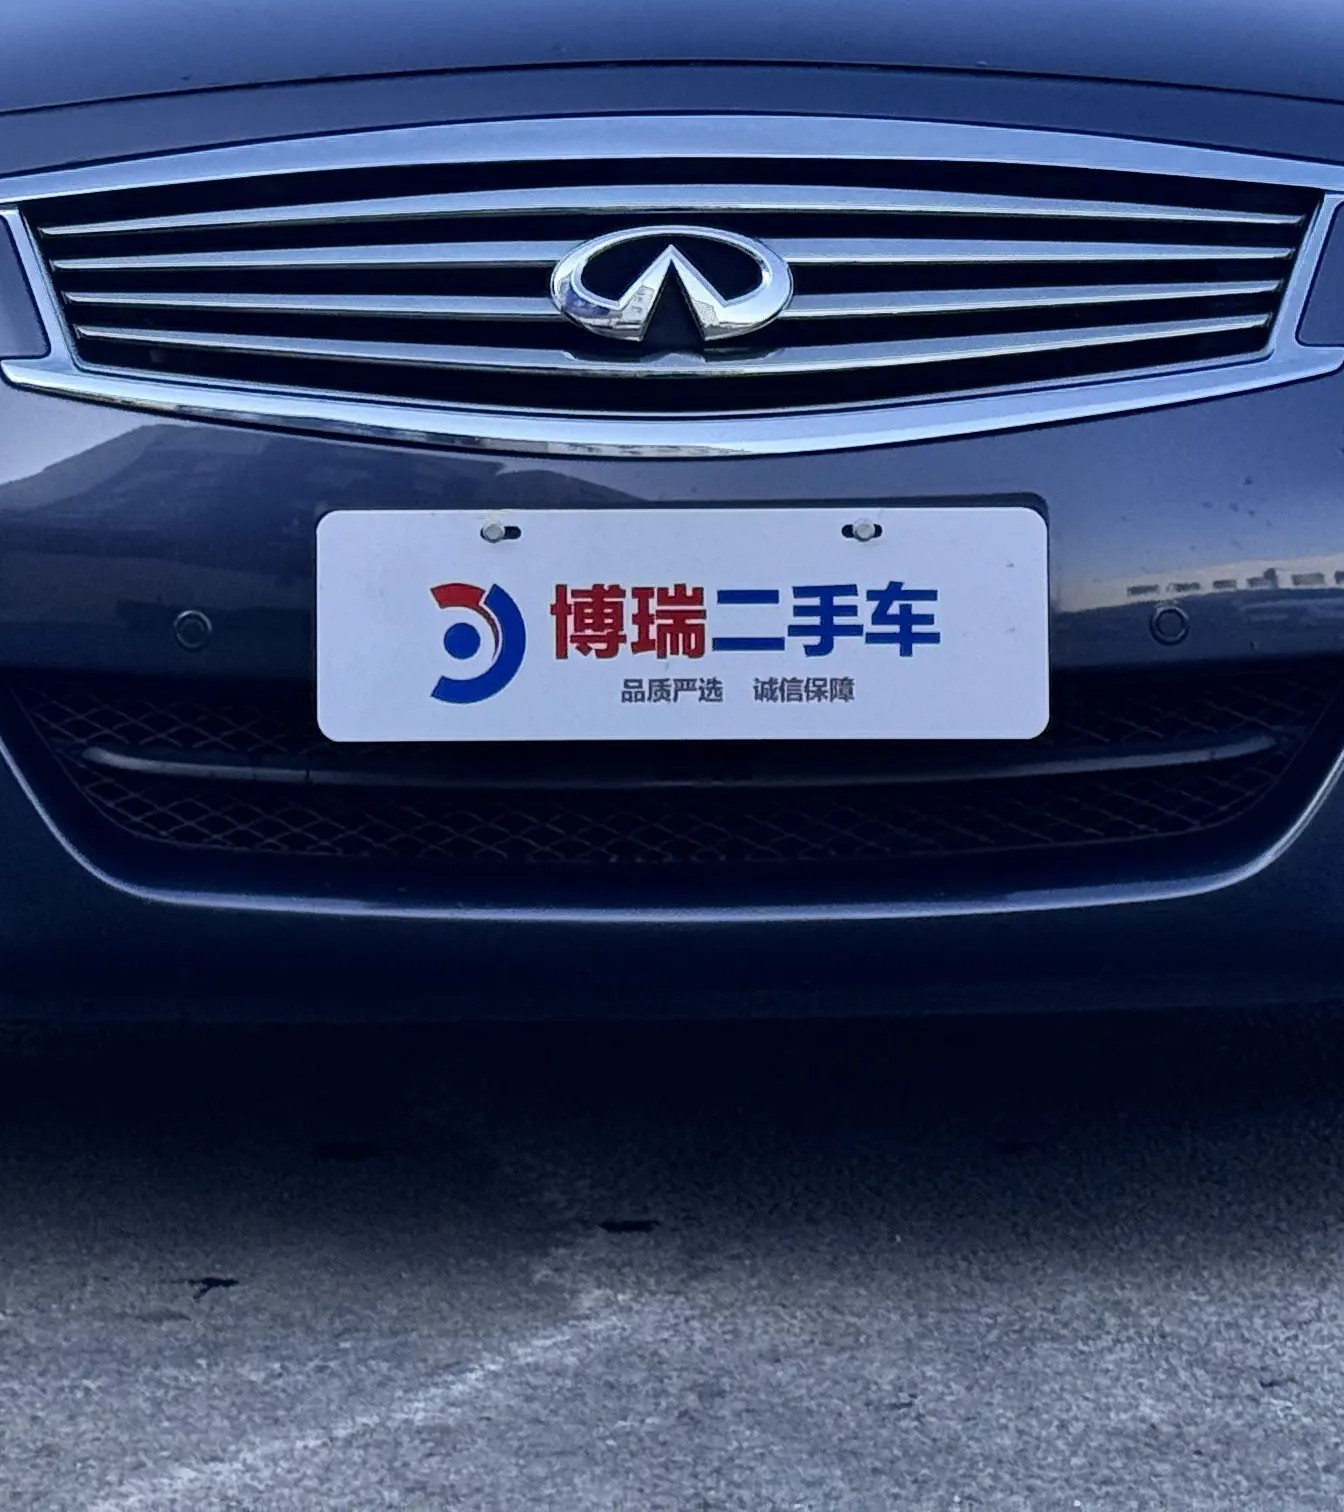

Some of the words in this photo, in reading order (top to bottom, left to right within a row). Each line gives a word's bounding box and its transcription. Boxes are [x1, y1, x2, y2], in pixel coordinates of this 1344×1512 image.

[550, 581, 941, 660] 博瑞二手车
[621, 678, 724, 704] 品质严选
[753, 676, 856, 704] 诚信保障
